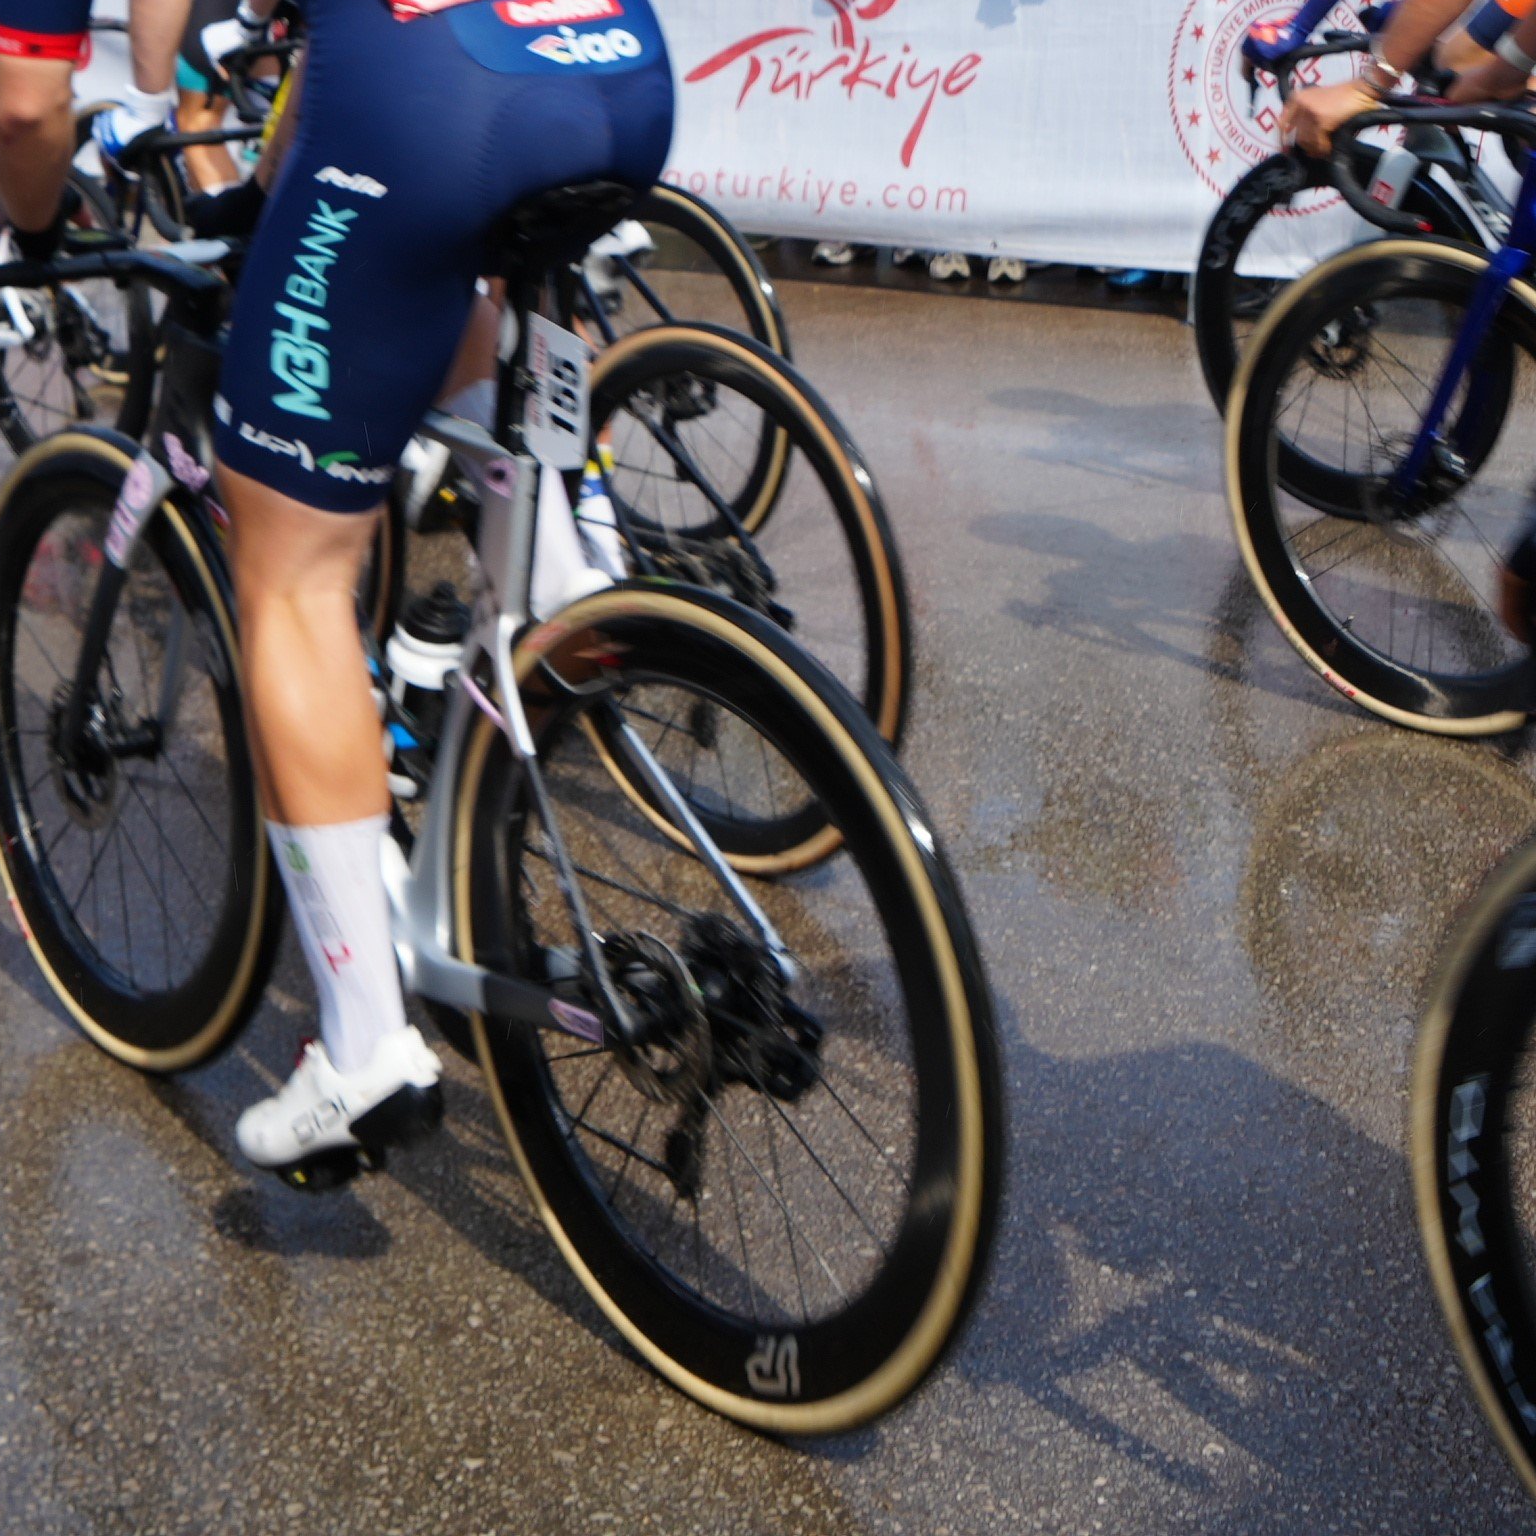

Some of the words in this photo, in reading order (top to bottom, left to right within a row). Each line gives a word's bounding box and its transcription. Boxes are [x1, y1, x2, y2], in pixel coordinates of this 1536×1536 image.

[683, 27, 983, 169] Türkiye
[1210, 82, 1223, 103] OF
[284, 198, 359, 308] BANK
[269, 300, 333, 422] MBH
